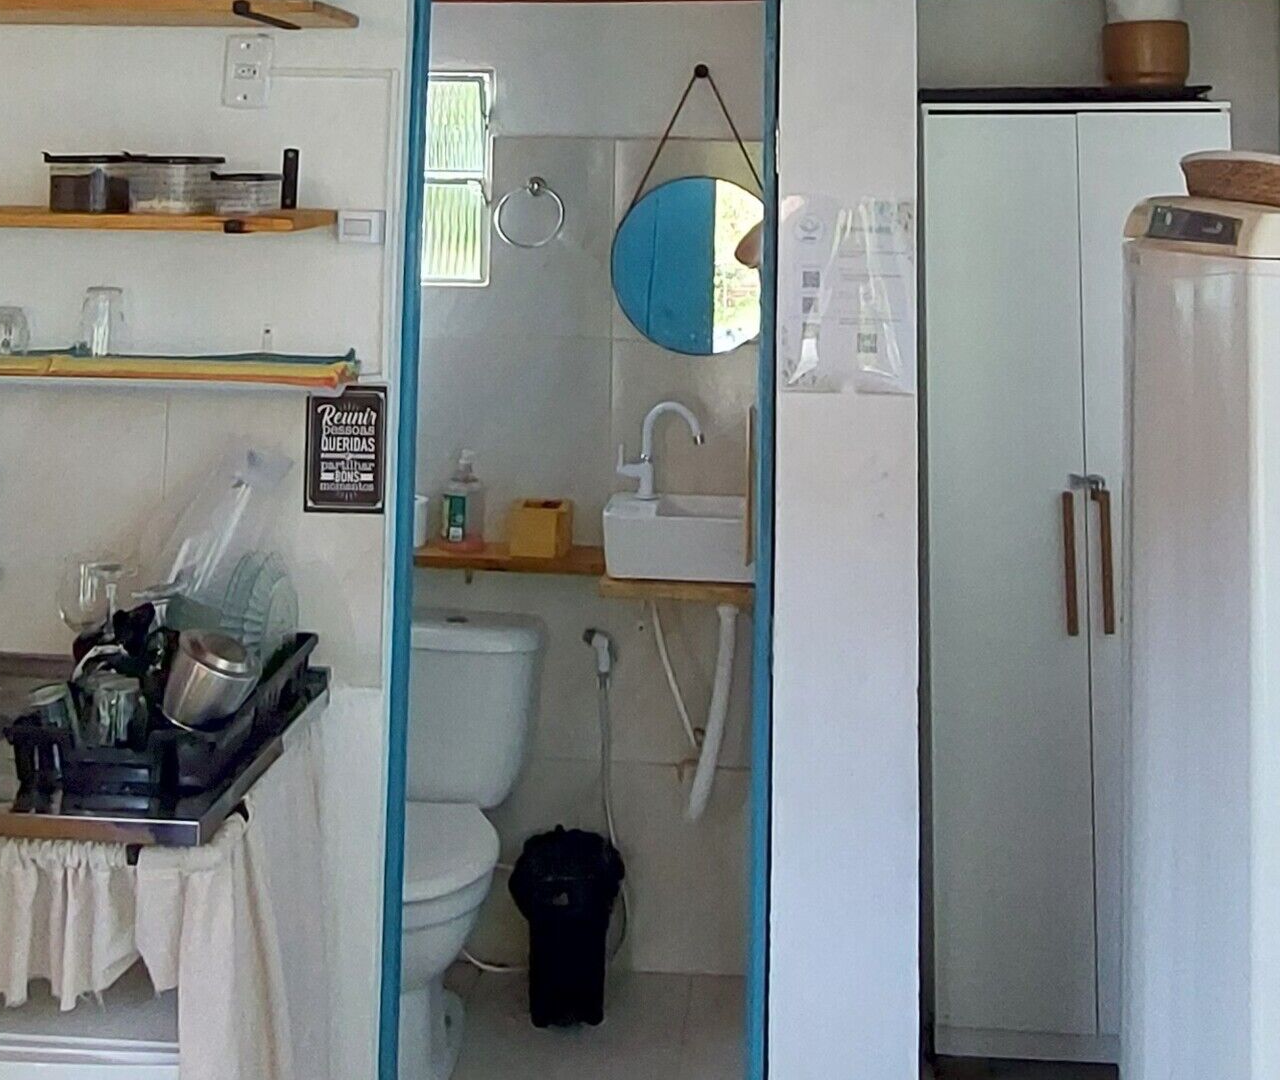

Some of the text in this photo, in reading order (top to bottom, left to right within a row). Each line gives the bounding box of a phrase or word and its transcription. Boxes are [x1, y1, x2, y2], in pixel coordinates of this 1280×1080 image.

[317, 404, 377, 426] Reunir
[321, 437, 375, 452] QUERIDAS
[320, 460, 375, 472] partilhar
[335, 470, 361, 482] BONS
